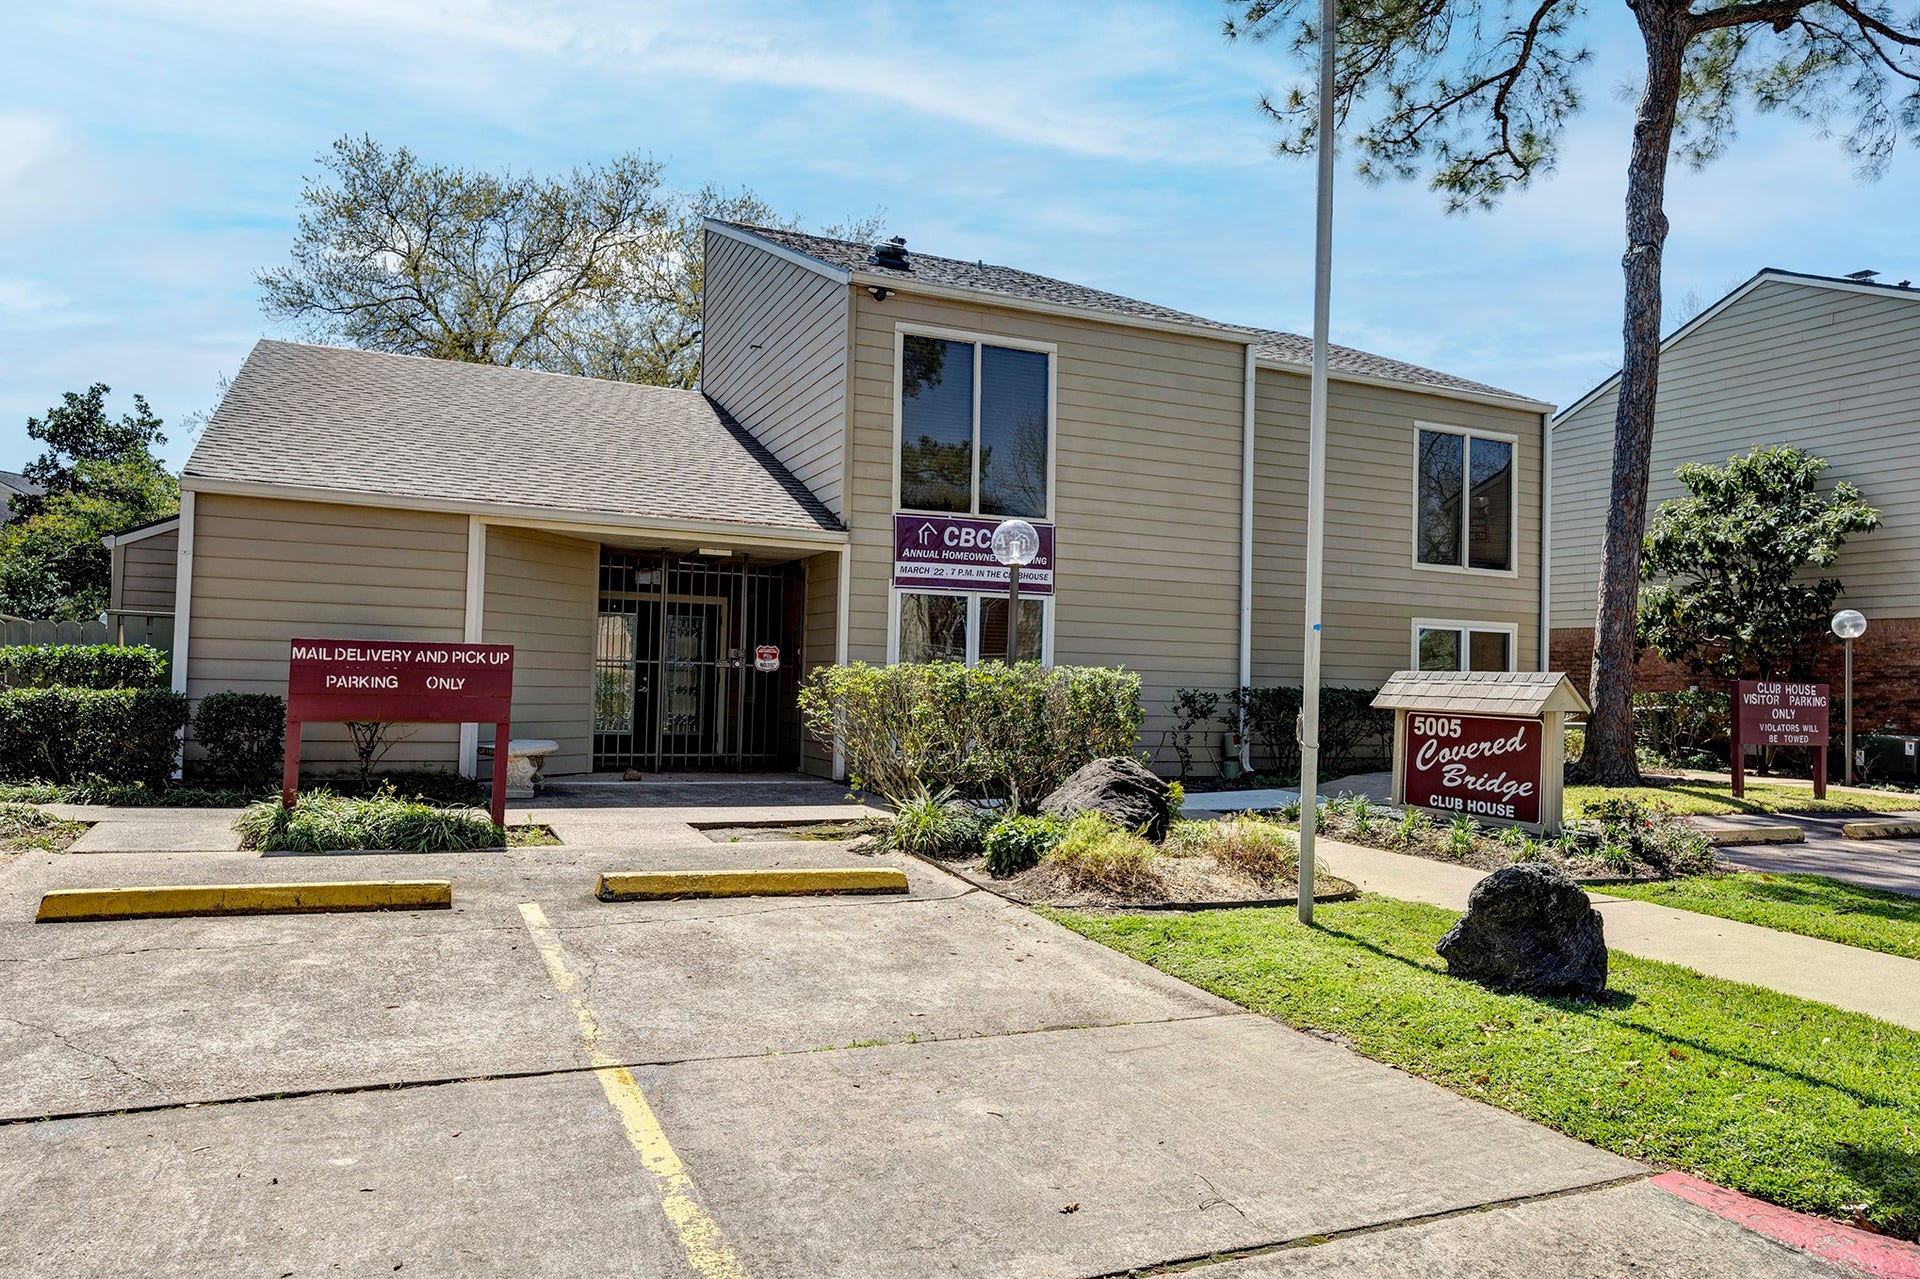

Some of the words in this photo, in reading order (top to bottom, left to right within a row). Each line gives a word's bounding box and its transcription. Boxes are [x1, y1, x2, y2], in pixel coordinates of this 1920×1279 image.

[902, 548, 939, 559] ANNUAL
[900, 566, 930, 574] MARCH
[951, 568, 956, 576] 7
[958, 569, 974, 577] P.M.
[987, 570, 1001, 579] THE
[1003, 571, 1049, 581] CLBHOUSE
[291, 646, 332, 661] MAIL
[334, 647, 412, 662] DELIVERY
[415, 650, 448, 664] AND
[452, 651, 486, 664] PICK
[489, 652, 510, 665] UP
[326, 675, 399, 689] PARKING
[425, 676, 466, 690] ONLY
[1757, 682, 1781, 694] CLUB
[1785, 684, 1816, 696] HOUSE
[1743, 693, 1780, 706] VISITOR
[1789, 695, 1827, 707] PARKING
[1772, 708, 1796, 719] ONLY
[1413, 717, 1462, 738] 5005
[1759, 723, 1800, 733] VIOLATORS
[1802, 724, 1819, 733] WILL
[1769, 734, 1778, 743] BE
[1784, 735, 1809, 744] TOWED
[1416, 726, 1528, 772] Covered
[1441, 763, 1534, 802] Bridge
[1429, 794, 1463, 810] CLUB
[1467, 799, 1515, 818] HOUSE
